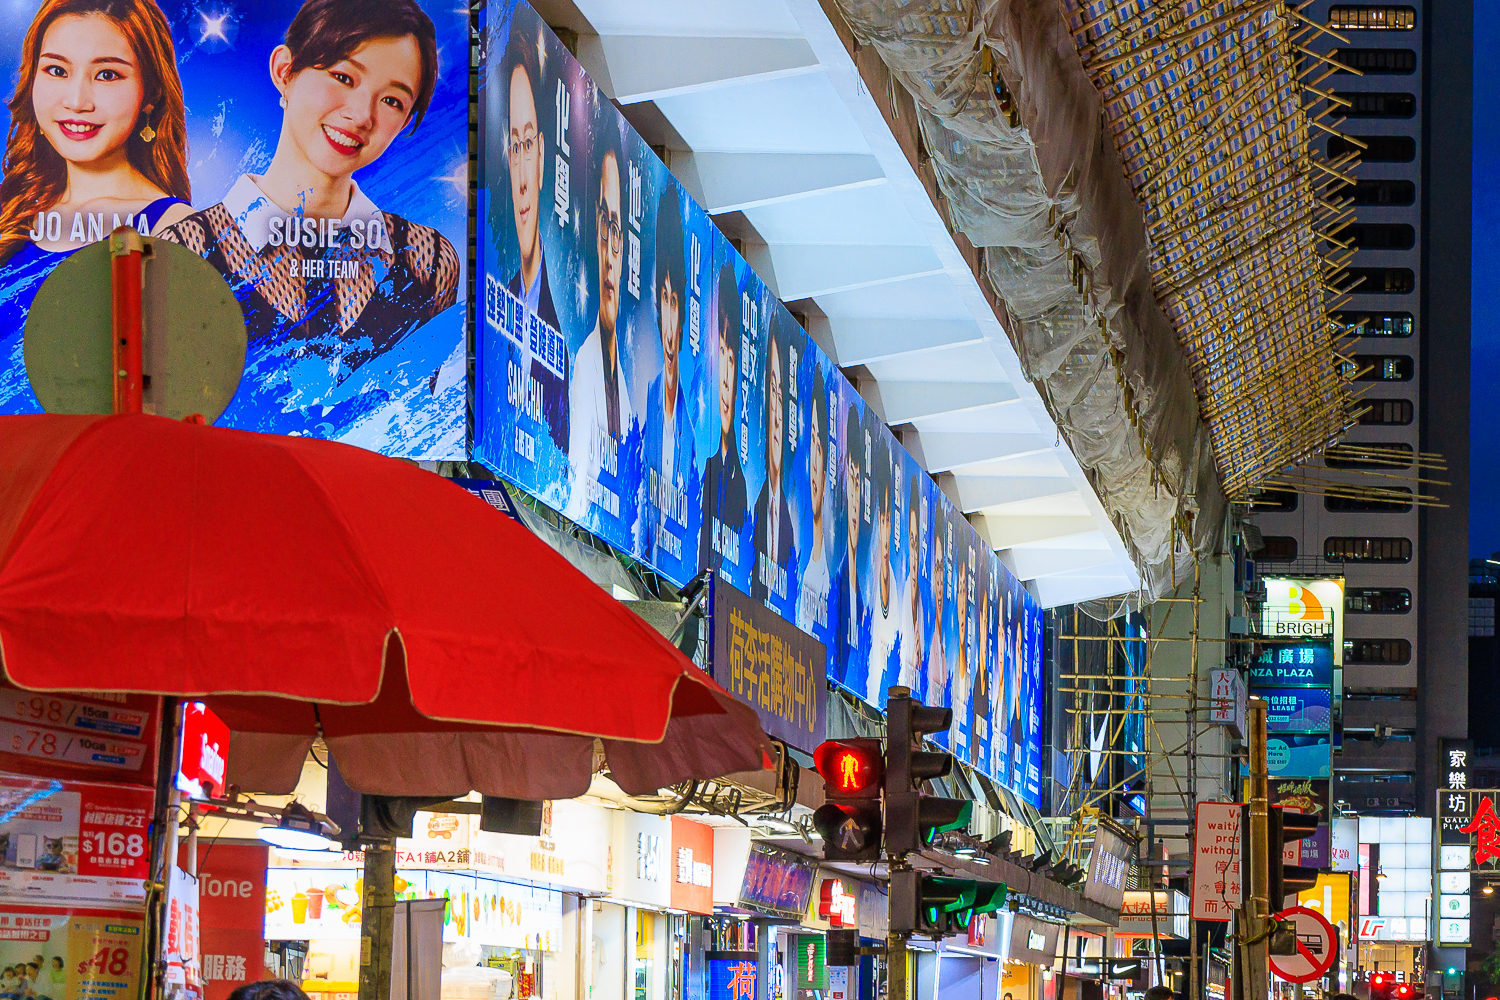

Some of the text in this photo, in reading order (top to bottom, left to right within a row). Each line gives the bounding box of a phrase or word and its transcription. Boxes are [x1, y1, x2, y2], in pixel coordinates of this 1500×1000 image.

[555, 78, 570, 228] 化學
[28, 213, 61, 242] JO
[70, 213, 103, 242] AN
[268, 217, 382, 251] SUSIE SO
[290, 260, 359, 279] & HER TEAM
[508, 360, 543, 425] SAM CHAI
[1276, 622, 1332, 634] BRIGHT
[730, 607, 816, 733] 荷李活購物中心
[1277, 668, 1314, 677] PLAZA
[16, 697, 109, 722] $98 15GB
[13, 730, 106, 755] $78 10GB
[1449, 750, 1466, 813] 家樂坊
[1208, 821, 1239, 830] waiti
[83, 832, 143, 857] $168
[1201, 845, 1239, 855] withou
[78, 947, 129, 976] $48
